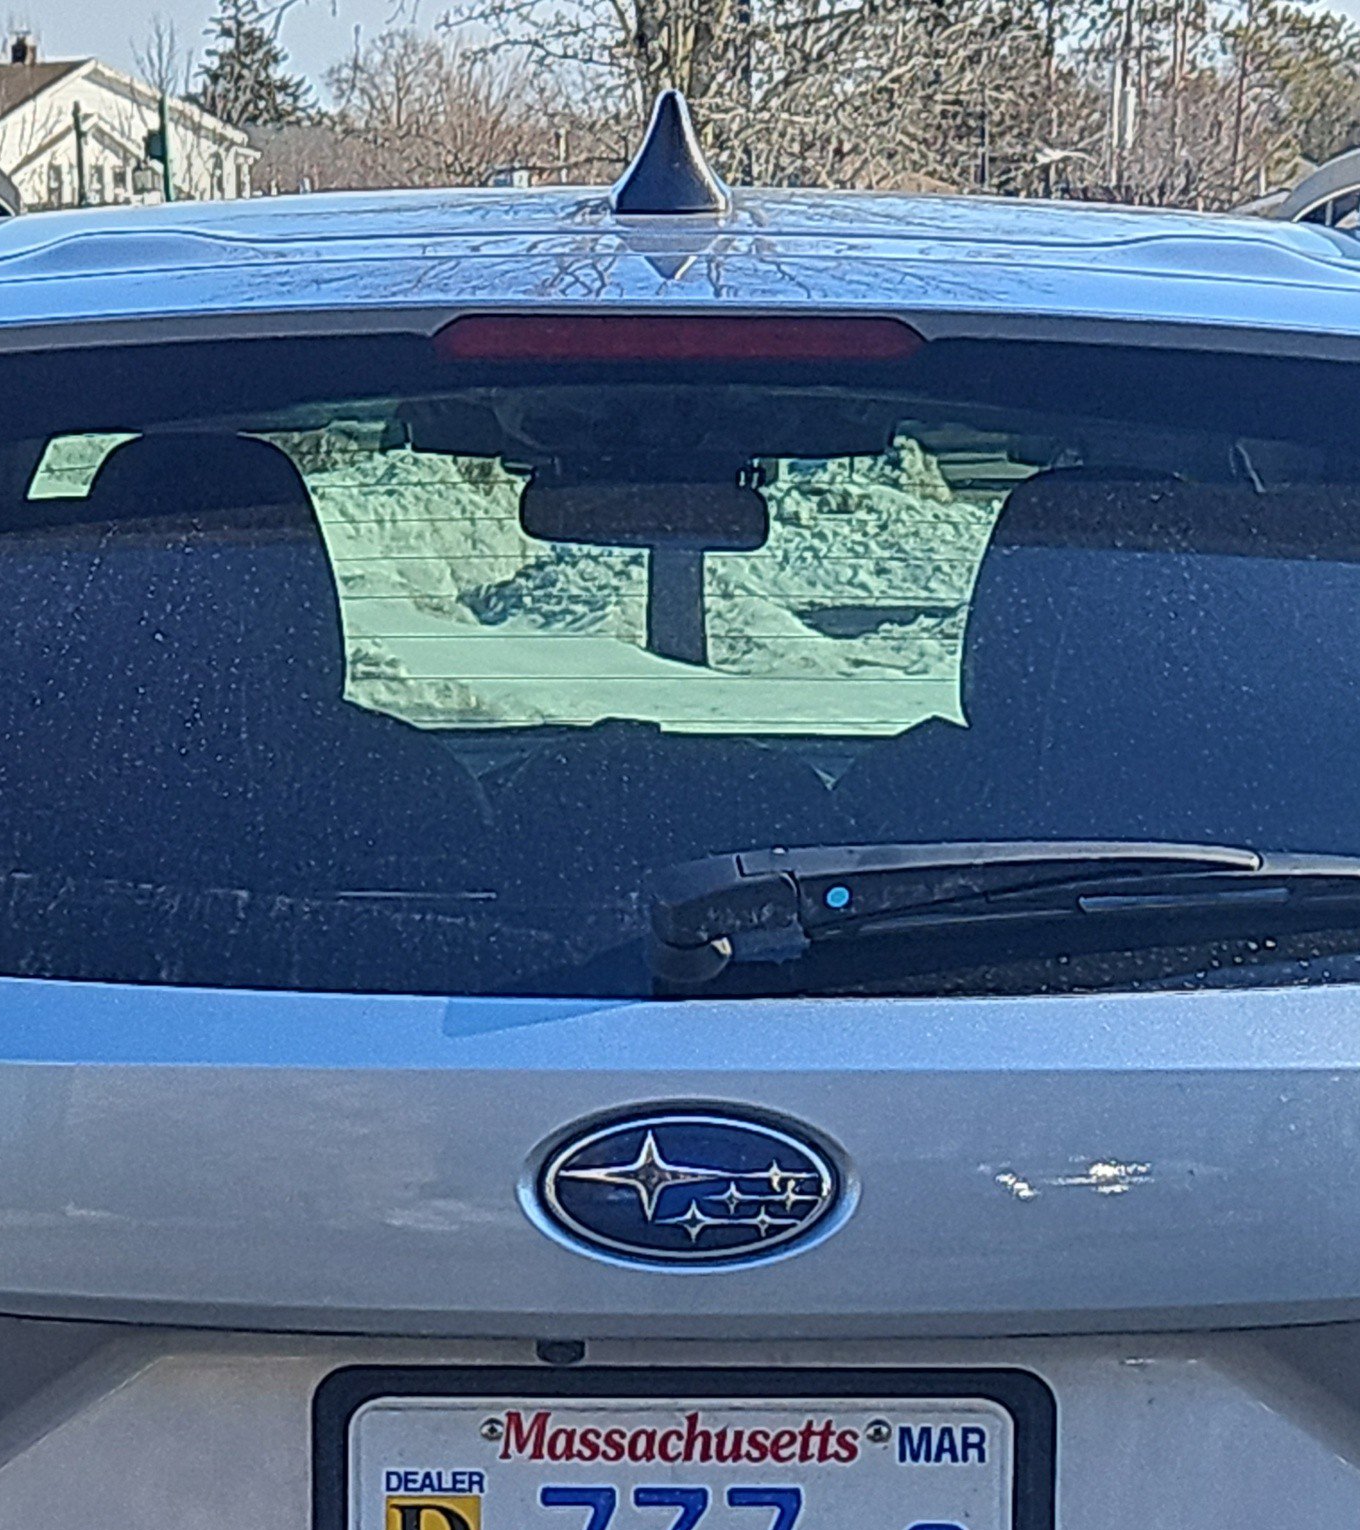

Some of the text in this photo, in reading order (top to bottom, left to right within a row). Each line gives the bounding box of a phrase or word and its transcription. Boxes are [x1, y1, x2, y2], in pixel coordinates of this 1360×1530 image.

[498, 1411, 860, 1464] Massachusetts
[898, 1426, 986, 1464] MAR
[384, 1471, 485, 1493] DEALER
